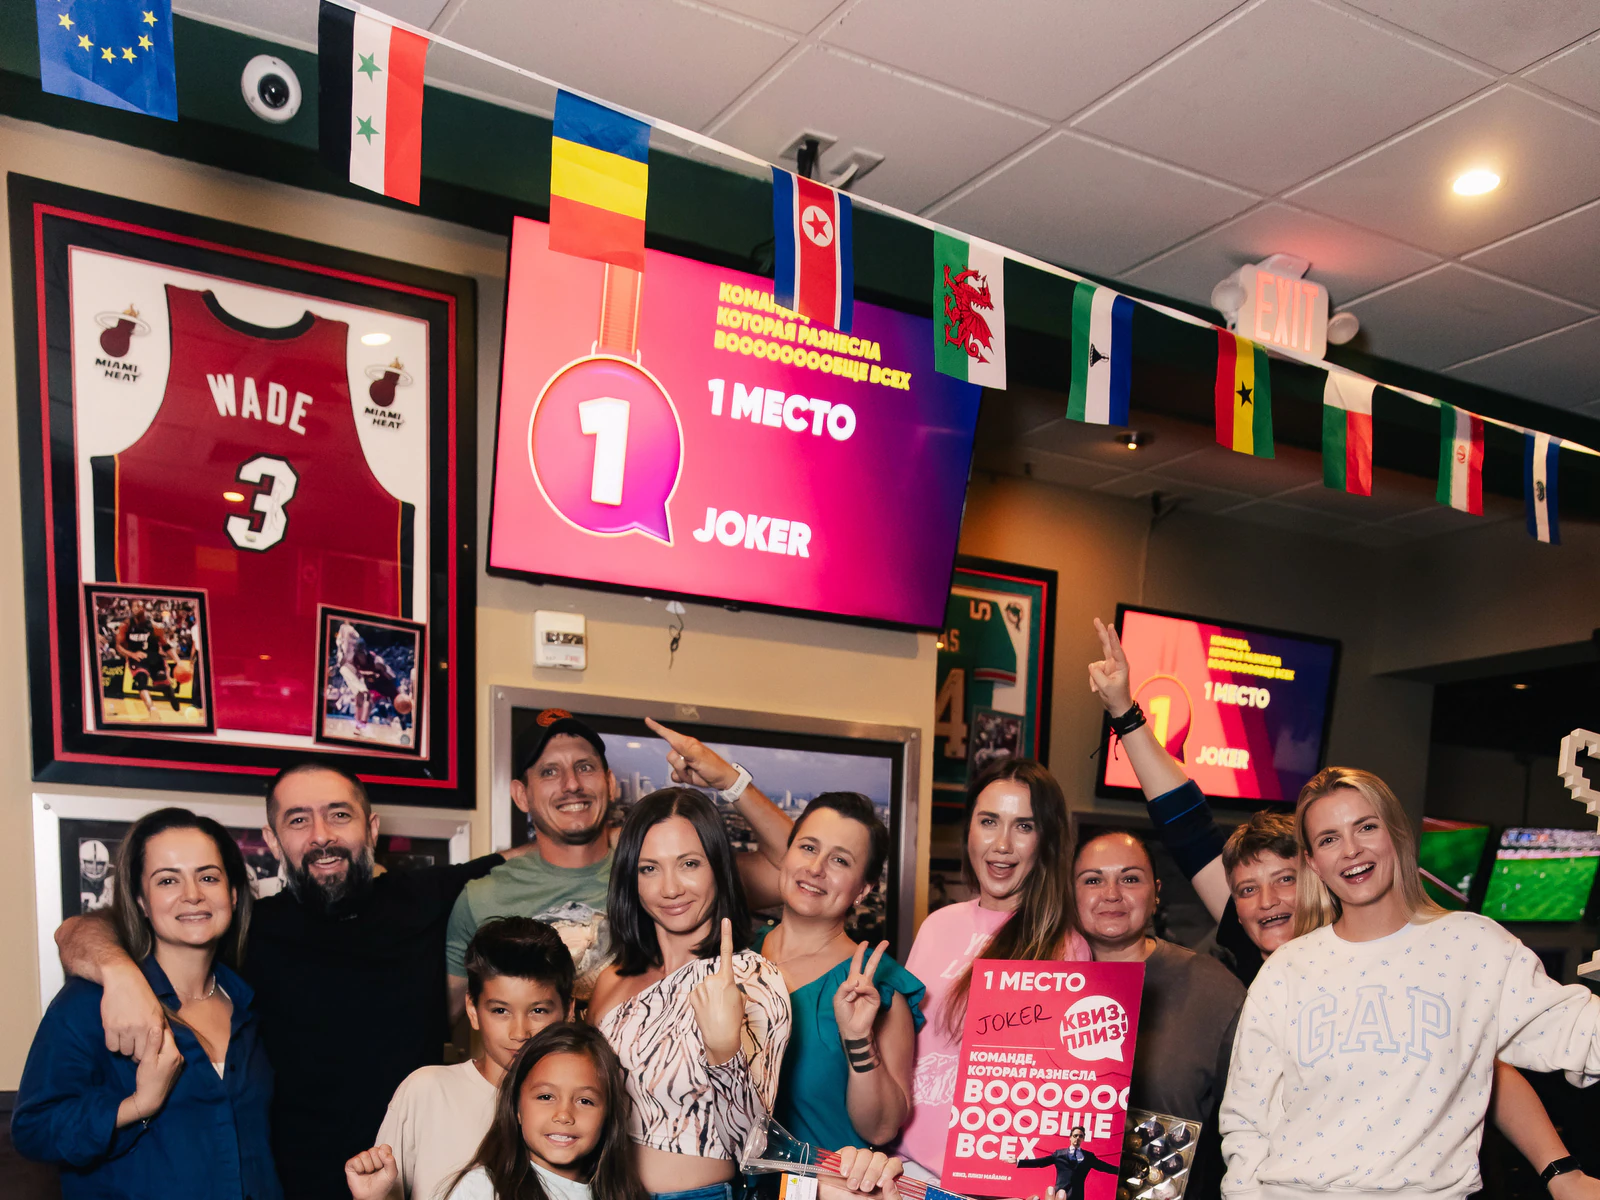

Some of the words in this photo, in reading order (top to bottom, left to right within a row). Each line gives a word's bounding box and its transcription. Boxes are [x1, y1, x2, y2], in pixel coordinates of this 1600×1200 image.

[719, 282, 811, 324] КОМАН,
[1254, 270, 1319, 352] EXIT
[716, 306, 797, 342] КОТОРАЯ
[798, 324, 882, 362] РАЗНЕСЛА
[95, 358, 138, 373] MIAMI
[105, 370, 139, 382] HEAT
[869, 365, 912, 391] ВСЕХ
[206, 373, 313, 435] WADE
[365, 407, 401, 420] MIAMI
[707, 378, 725, 416] 1
[730, 381, 857, 441] МЕСТО
[373, 418, 402, 429] HEAT
[578, 396, 631, 506] 1
[223, 453, 299, 552] 3
[693, 508, 812, 557] JOKER
[1204, 681, 1213, 701] 1
[1213, 682, 1270, 709] МЕСТО
[1149, 695, 1171, 748] 1
[1195, 746, 1249, 769] JOKER
[984, 971, 993, 989] 1
[1000, 972, 1086, 992] МЕСТО
[976, 1004, 1053, 1035] JOKER
[1297, 984, 1452, 1067] GAP
[967, 1065, 1027, 1078] КОТОРАЯ
[1028, 1068, 1097, 1081] РАЗНЕСЛА
[969, 1051, 1036, 1066] КОМАНДЕ,
[955, 1132, 1040, 1161] ВСЕХ
